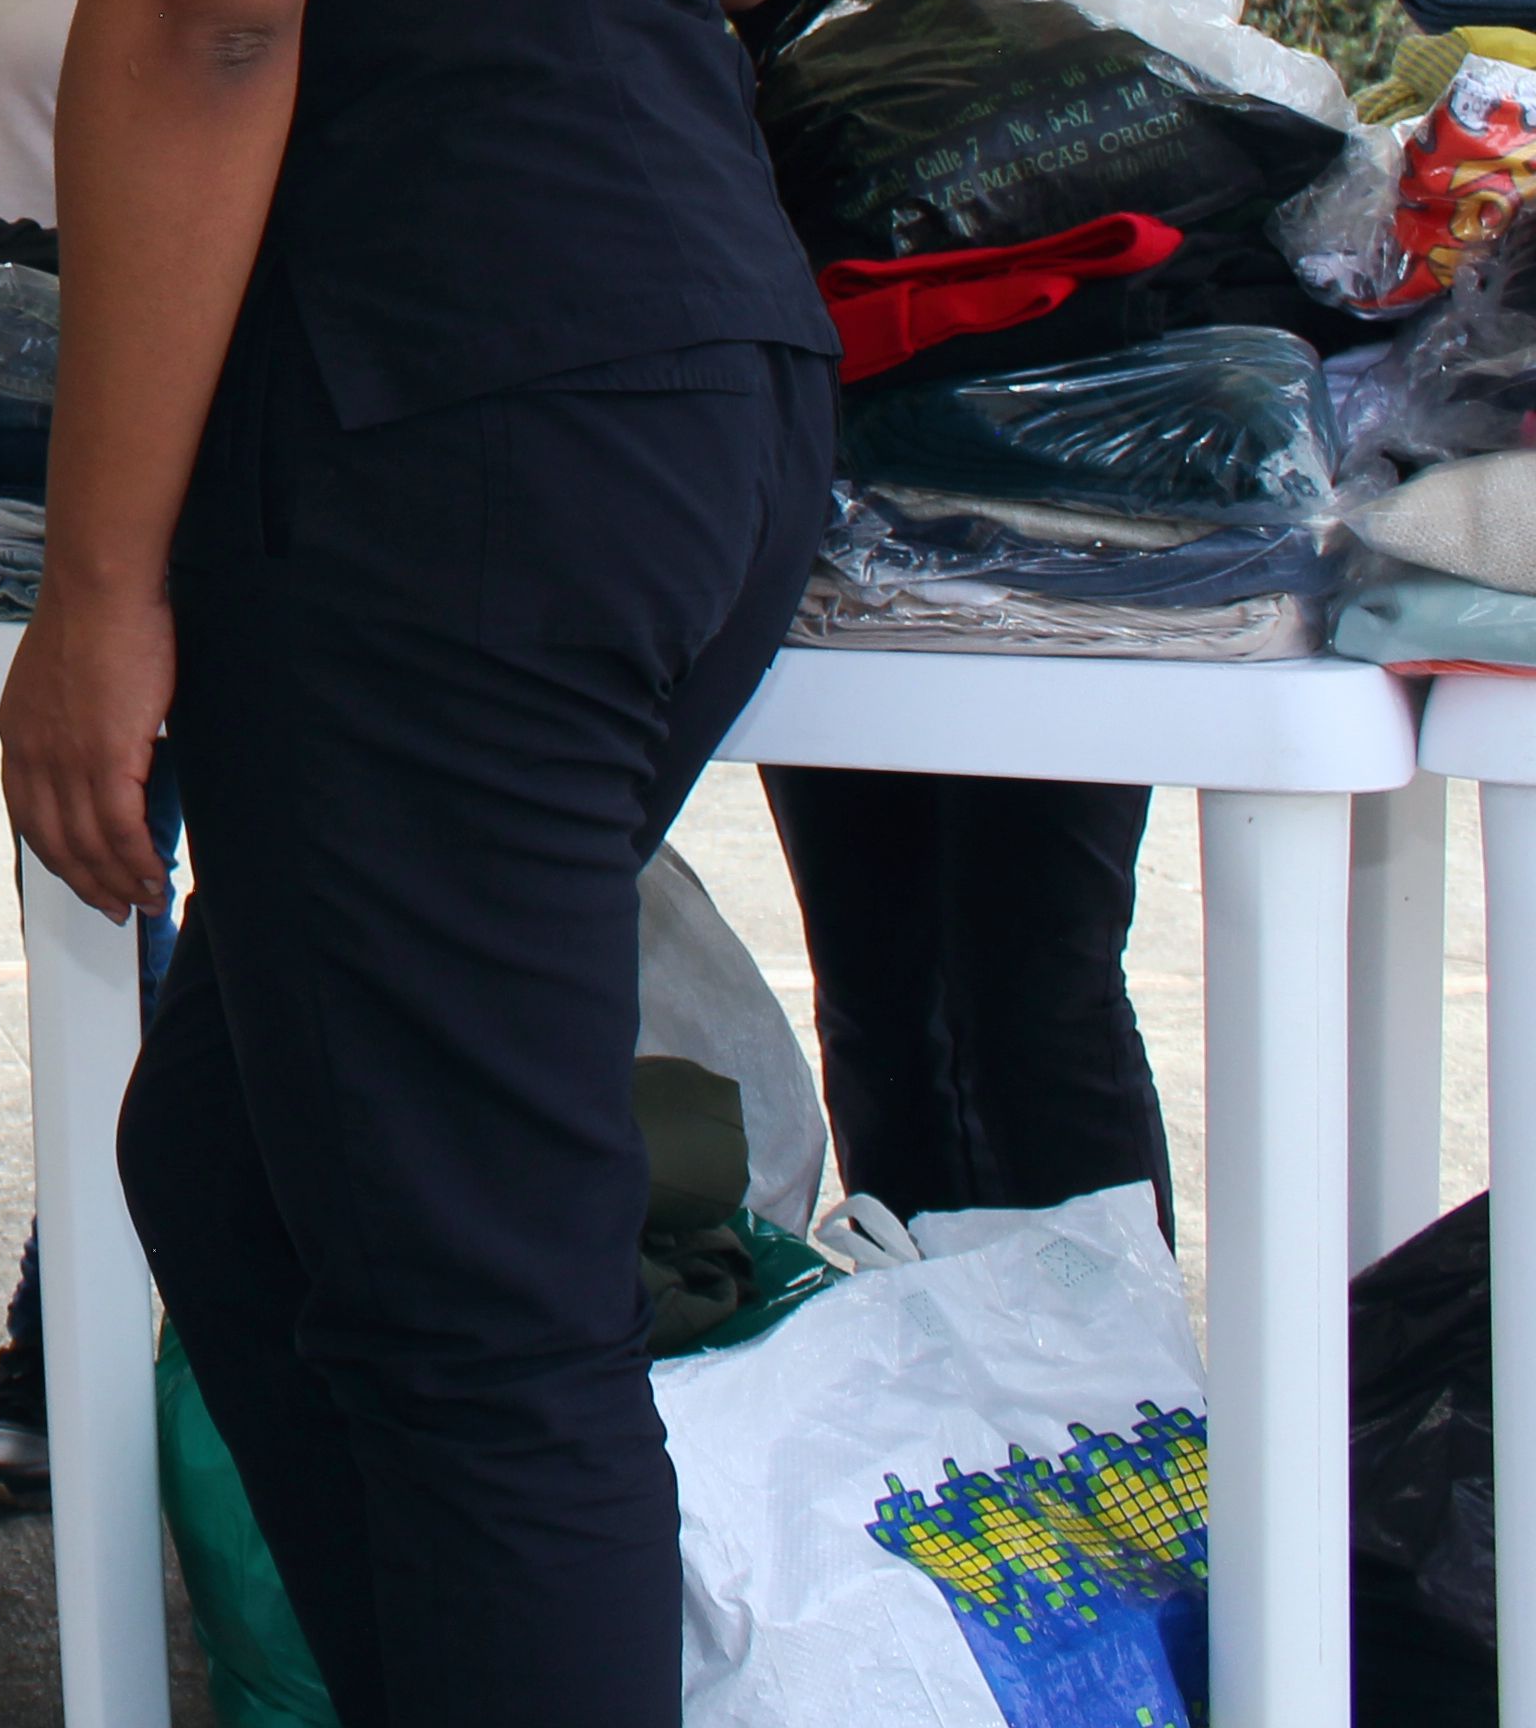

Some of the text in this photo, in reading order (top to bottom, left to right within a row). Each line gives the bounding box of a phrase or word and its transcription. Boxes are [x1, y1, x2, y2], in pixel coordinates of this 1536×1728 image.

[914, 145, 964, 183] Calle
[965, 136, 981, 163] 7
[1006, 115, 1043, 148] No.
[980, 138, 1090, 192] MARCAS
[1098, 108, 1196, 155] ORIGIN
